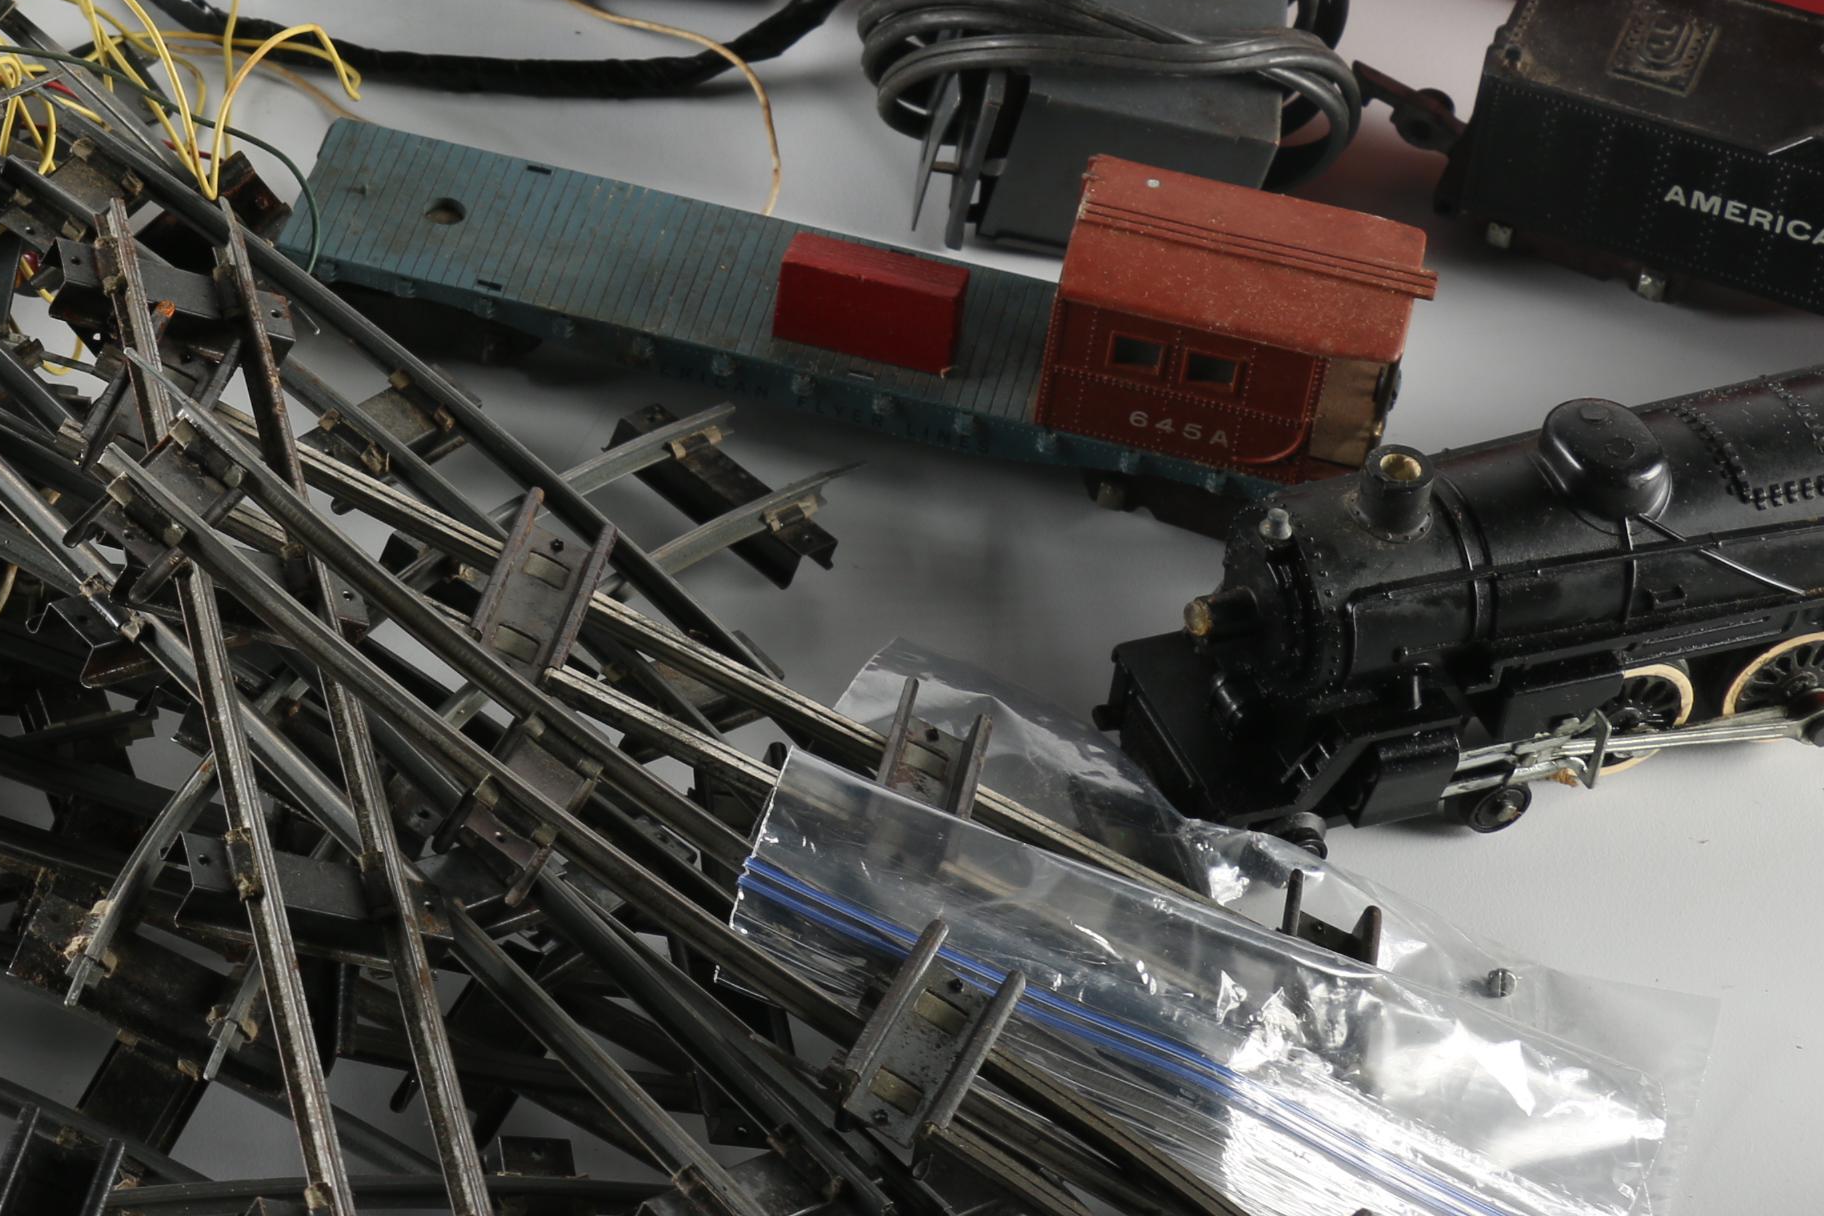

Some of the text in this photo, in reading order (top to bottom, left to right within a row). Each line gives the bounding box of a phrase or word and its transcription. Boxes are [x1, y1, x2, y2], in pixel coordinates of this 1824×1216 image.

[1664, 184, 1824, 245] AMERICA
[906, 421, 992, 455] LINES
[1129, 409, 1229, 448] 645A
